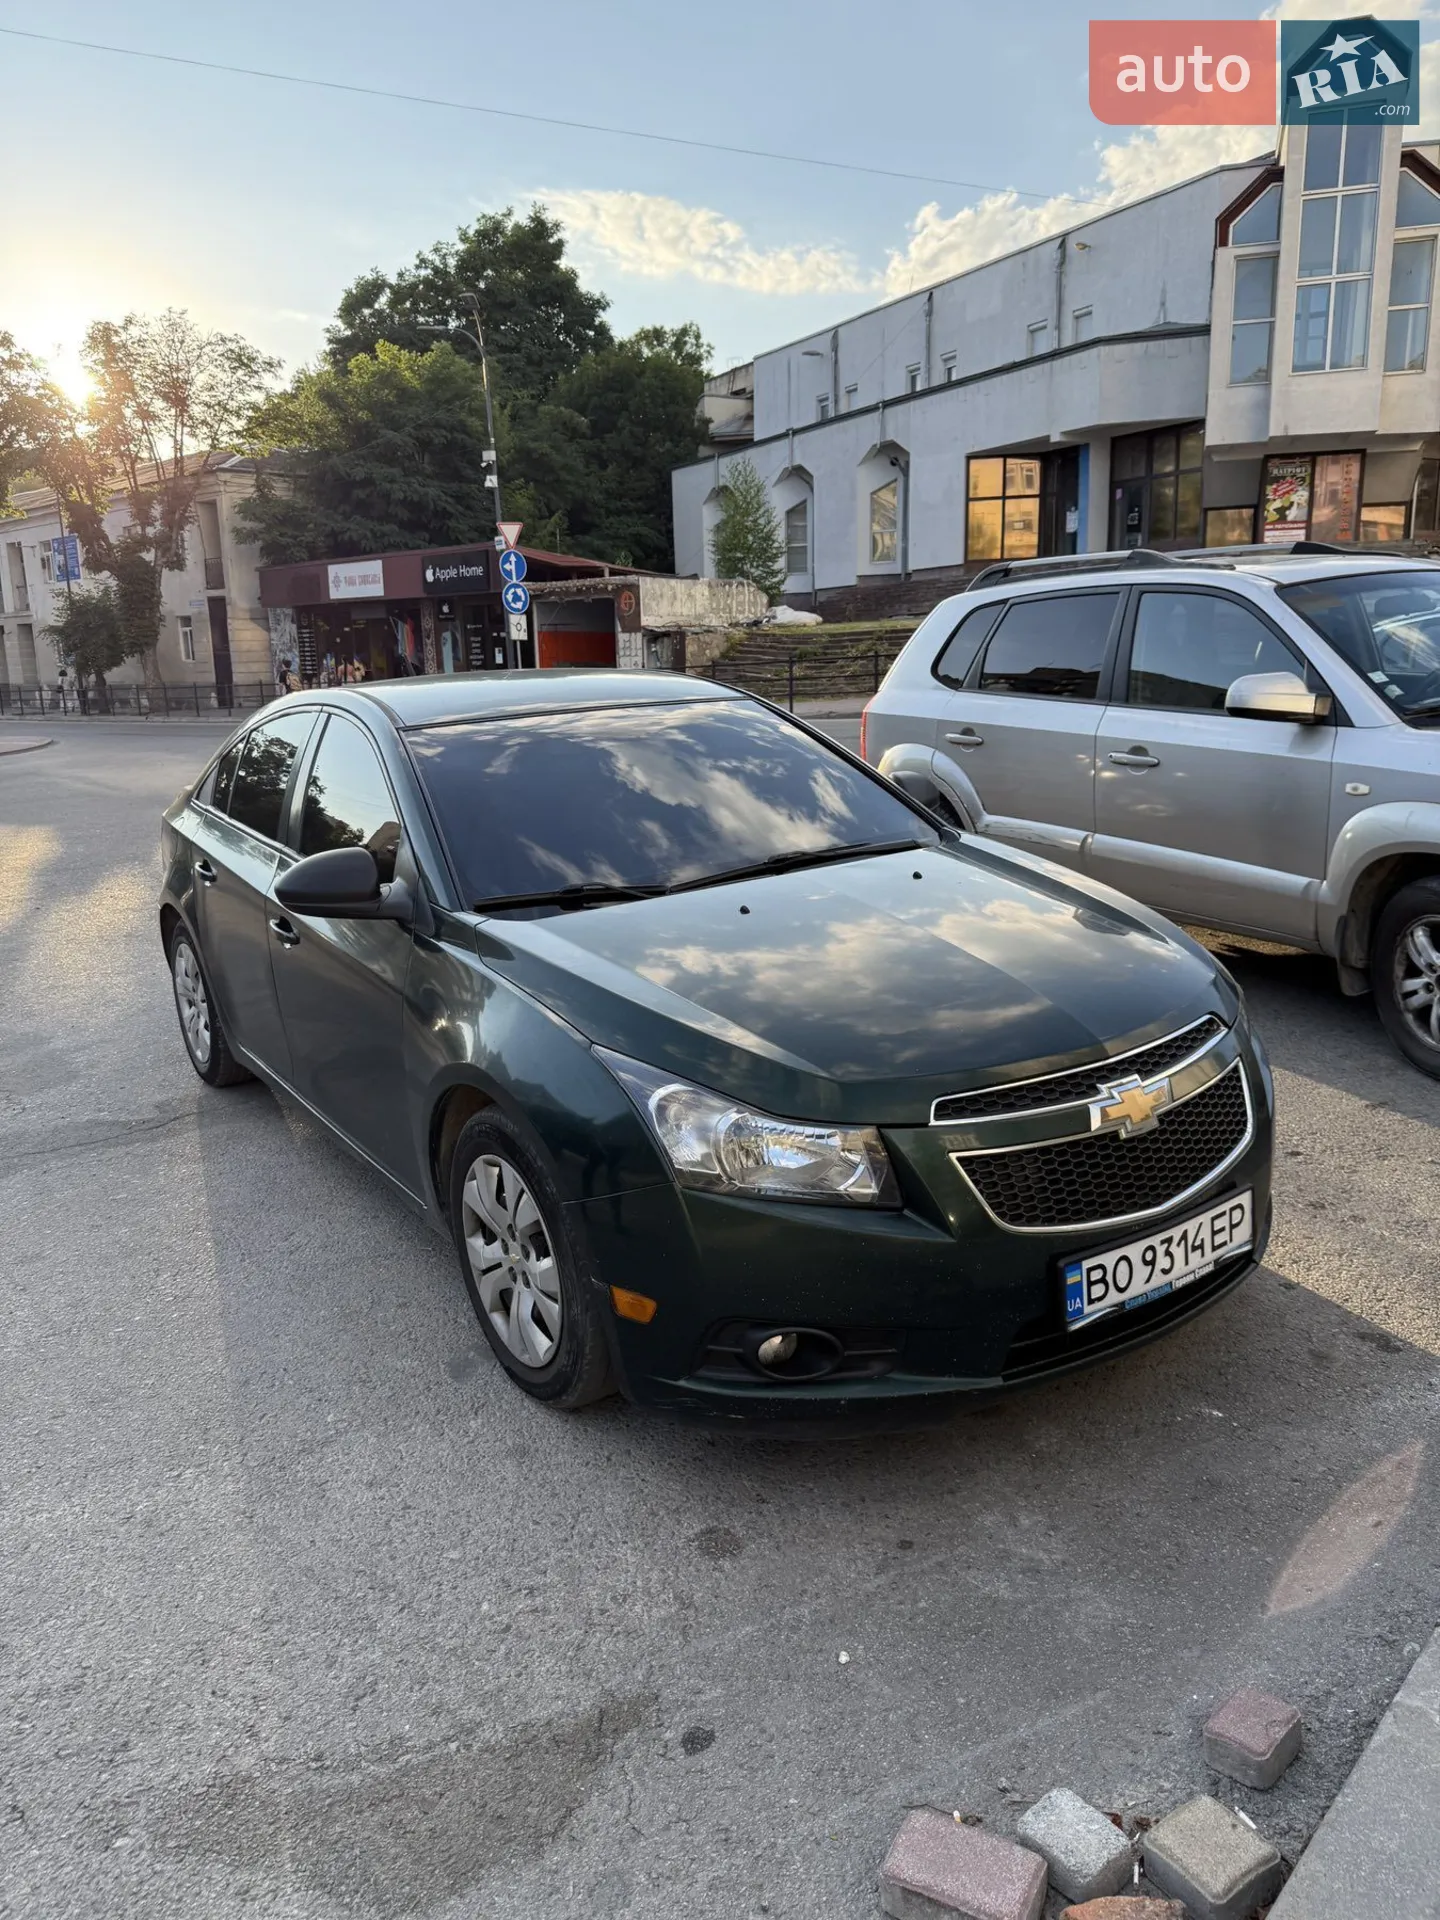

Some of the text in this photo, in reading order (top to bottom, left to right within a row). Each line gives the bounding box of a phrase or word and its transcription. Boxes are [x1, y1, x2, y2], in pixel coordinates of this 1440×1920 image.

[435, 564, 484, 582] Apple Home
[1141, 1221, 1205, 1285] 9314
[1066, 1297, 1083, 1312] UA
